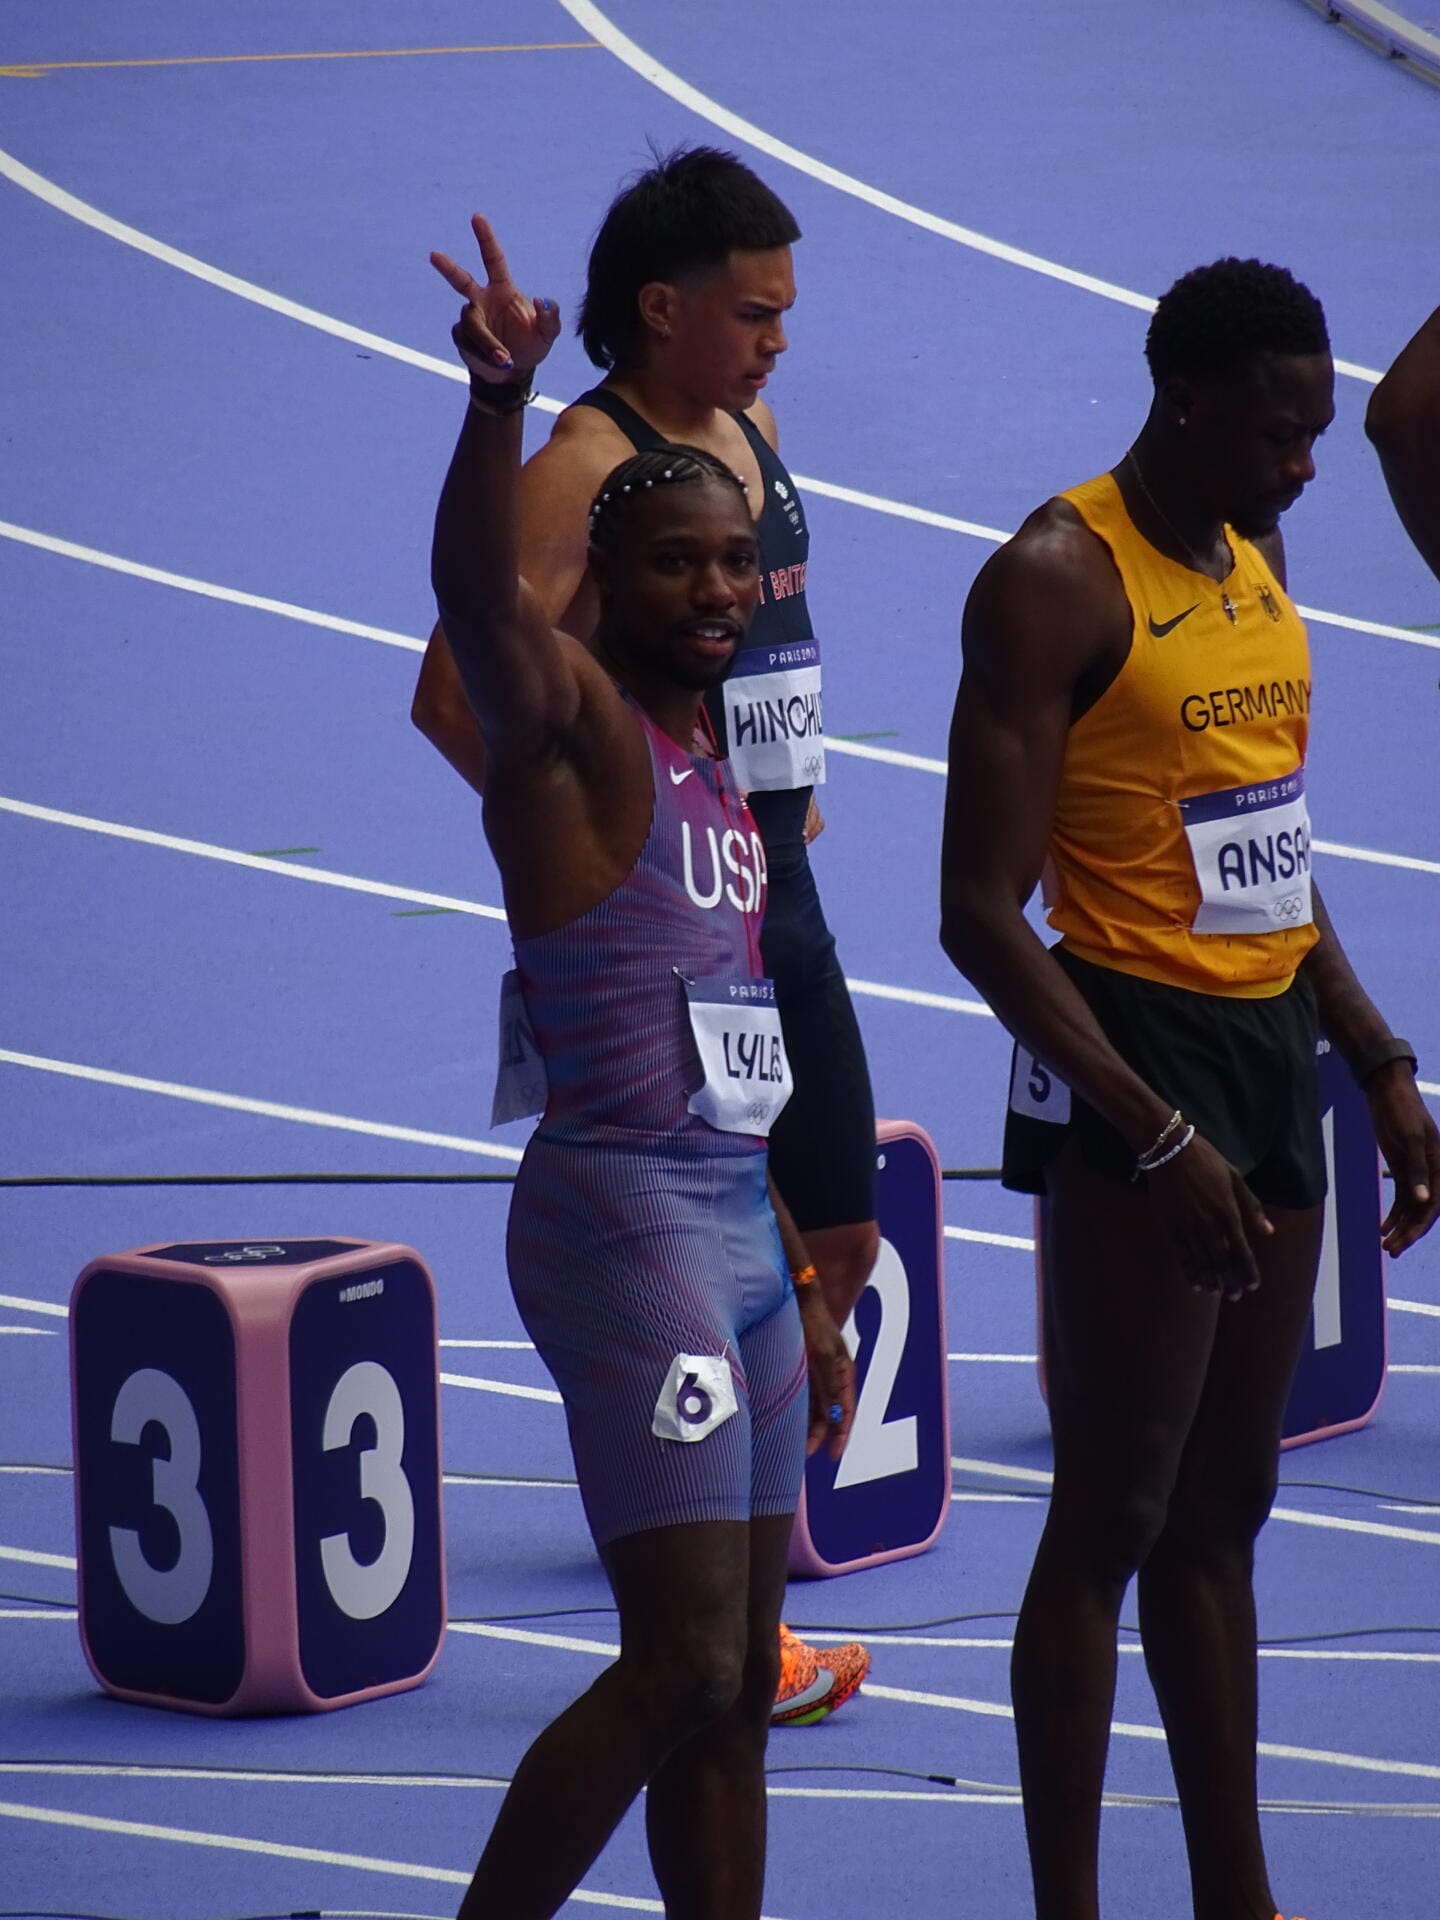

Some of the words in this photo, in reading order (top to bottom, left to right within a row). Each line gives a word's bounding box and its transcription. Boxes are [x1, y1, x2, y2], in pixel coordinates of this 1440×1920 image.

[769, 649, 801, 666] PARIS
[734, 692, 822, 747] HINCHL
[1181, 679, 1312, 732] GERMANY
[1236, 786, 1278, 807] PARIS
[682, 821, 768, 914] USA
[1218, 822, 1310, 892] ANSA
[729, 985, 769, 999] PARIS
[1028, 1059, 1051, 1104] 5
[346, 1279, 384, 1302] MONDO
[833, 1236, 919, 1490] 2
[676, 1372, 713, 1425] 6
[109, 1368, 213, 1625] 3
[320, 1361, 415, 1620] 3
